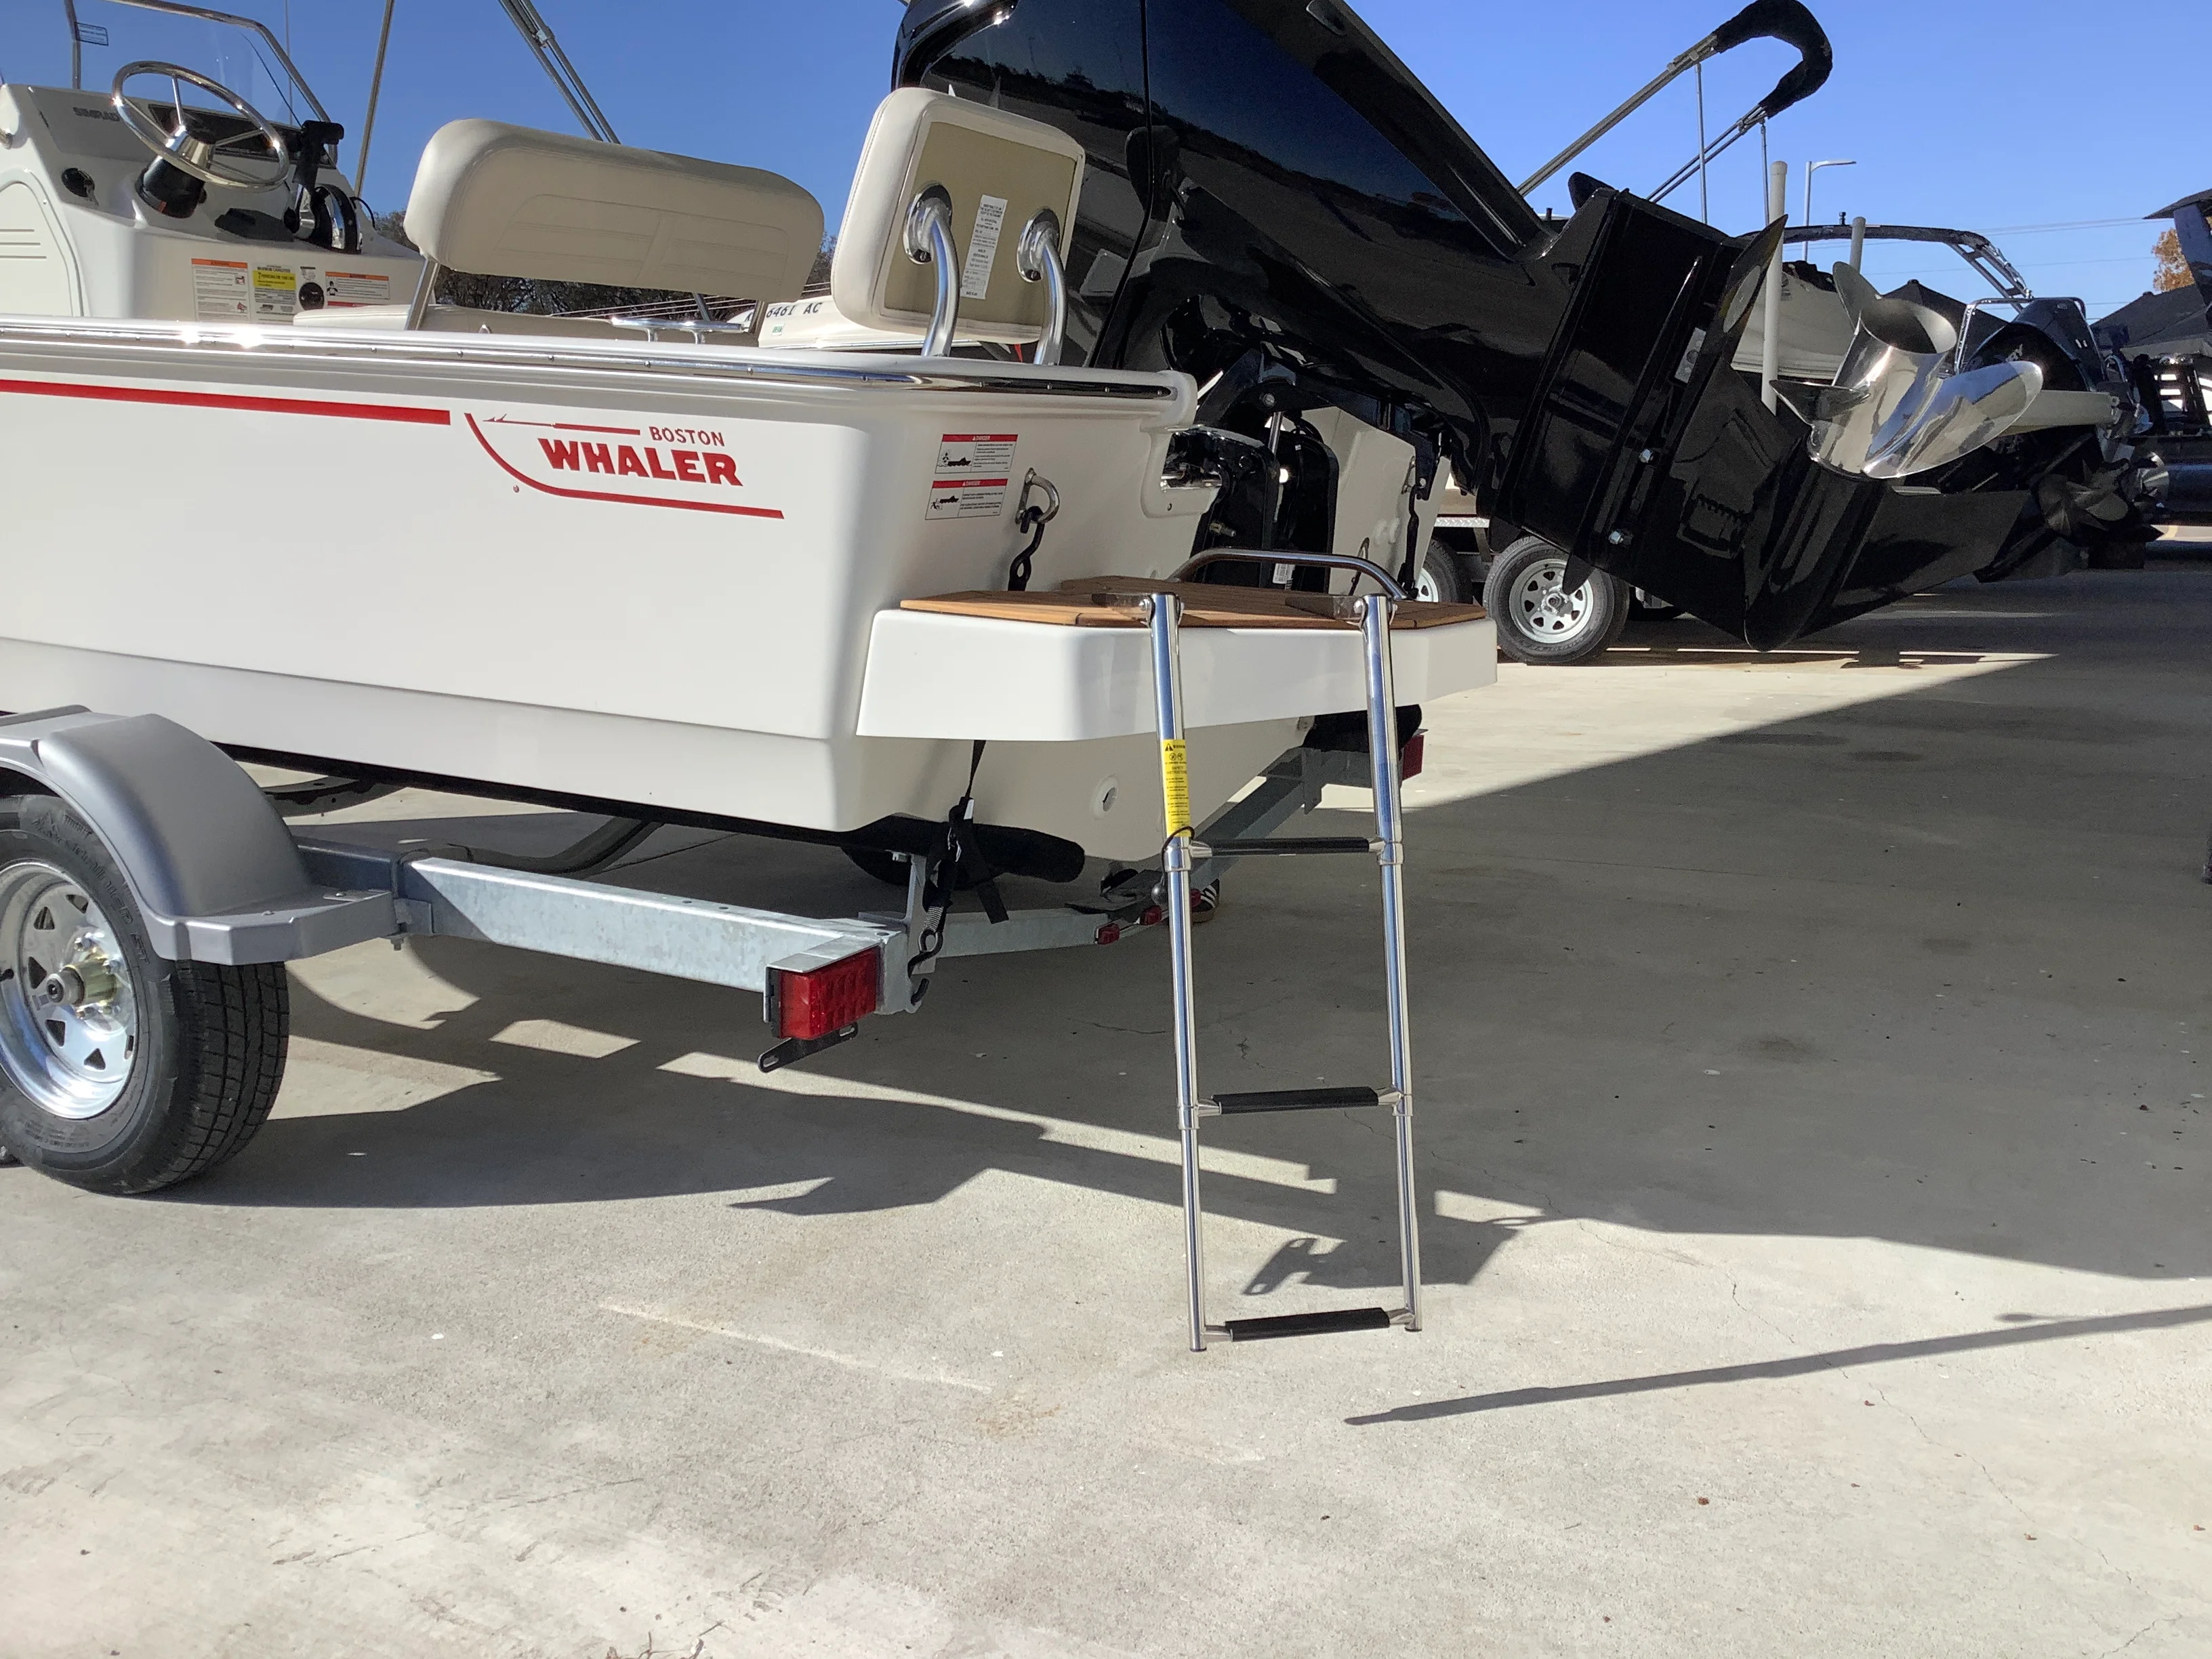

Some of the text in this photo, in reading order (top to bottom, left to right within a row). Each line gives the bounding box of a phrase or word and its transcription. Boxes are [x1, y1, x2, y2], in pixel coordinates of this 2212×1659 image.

[803, 302, 823, 314] AC
[649, 426, 725, 447] BOSTON
[537, 438, 743, 487] WHALER
